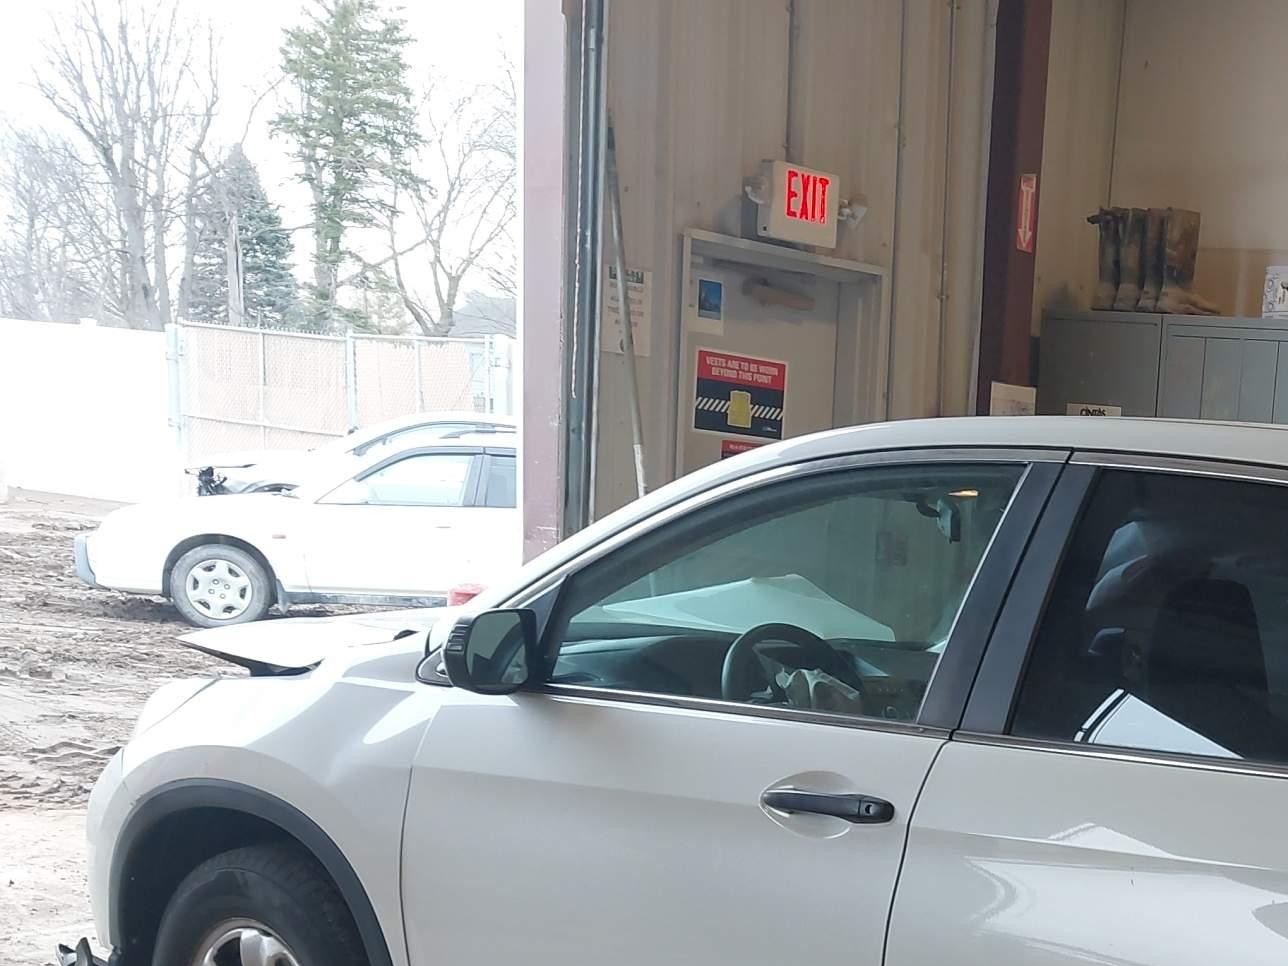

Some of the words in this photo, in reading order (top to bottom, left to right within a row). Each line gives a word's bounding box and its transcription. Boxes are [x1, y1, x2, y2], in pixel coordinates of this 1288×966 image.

[786, 169, 830, 225] EXIT
[740, 362, 749, 371] TO
[738, 371, 753, 381] THIS
